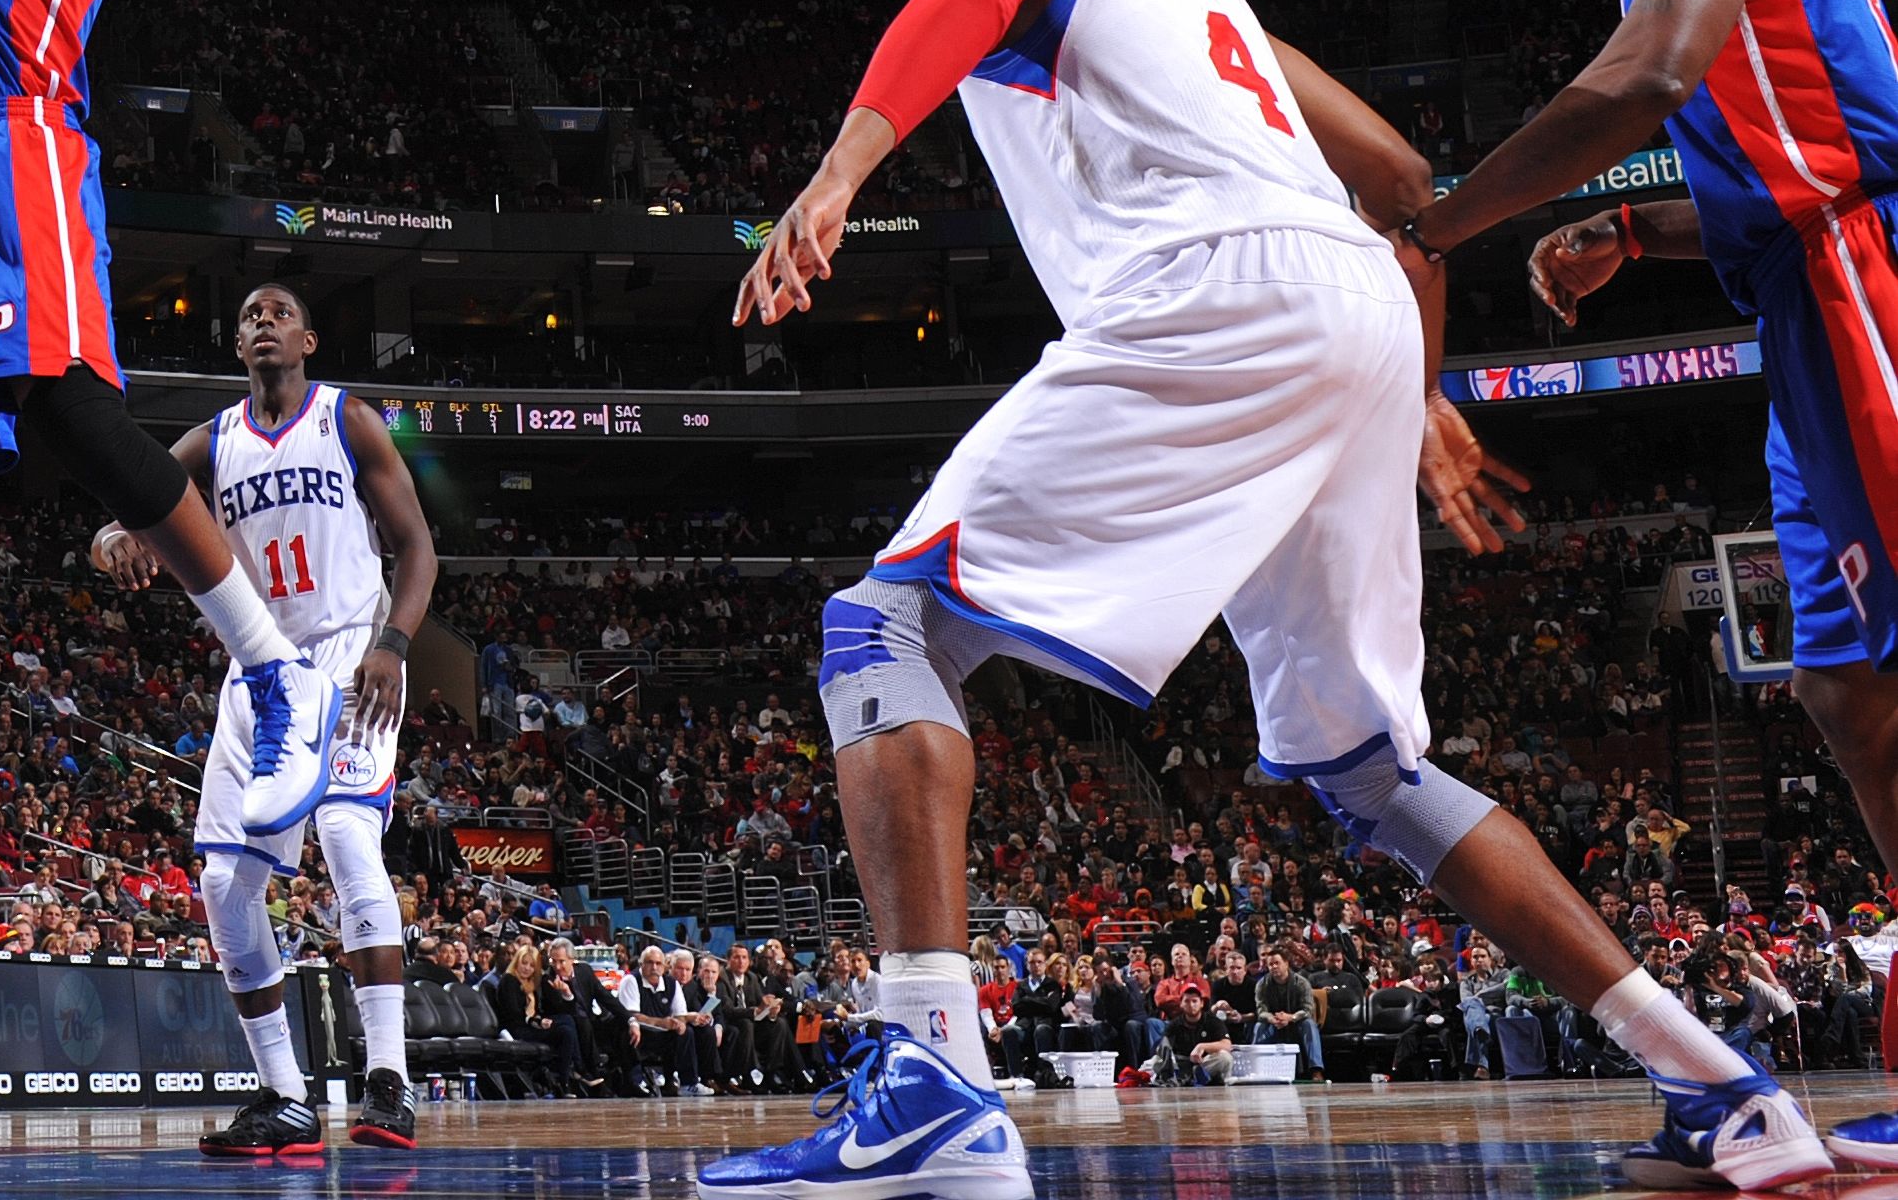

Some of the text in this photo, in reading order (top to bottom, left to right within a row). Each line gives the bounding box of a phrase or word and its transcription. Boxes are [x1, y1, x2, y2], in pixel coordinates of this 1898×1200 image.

[1206, 10, 1295, 138] 4
[323, 207, 452, 230] Main Line Health
[863, 216, 919, 232] Health
[1617, 343, 1738, 388] SIXERS
[529, 410, 603, 429] 8:22 PM
[615, 405, 642, 418] SAC
[683, 414, 709, 427] 9:00
[615, 420, 642, 433] UTA
[219, 467, 344, 530] SIXERS
[264, 534, 315, 599] 11
[1687, 588, 1723, 607] 120
[25, 1072, 79, 1094] GEICO
[89, 1072, 141, 1093] GEICO
[155, 1072, 203, 1092] GEICO
[214, 1072, 259, 1091] GEICO
